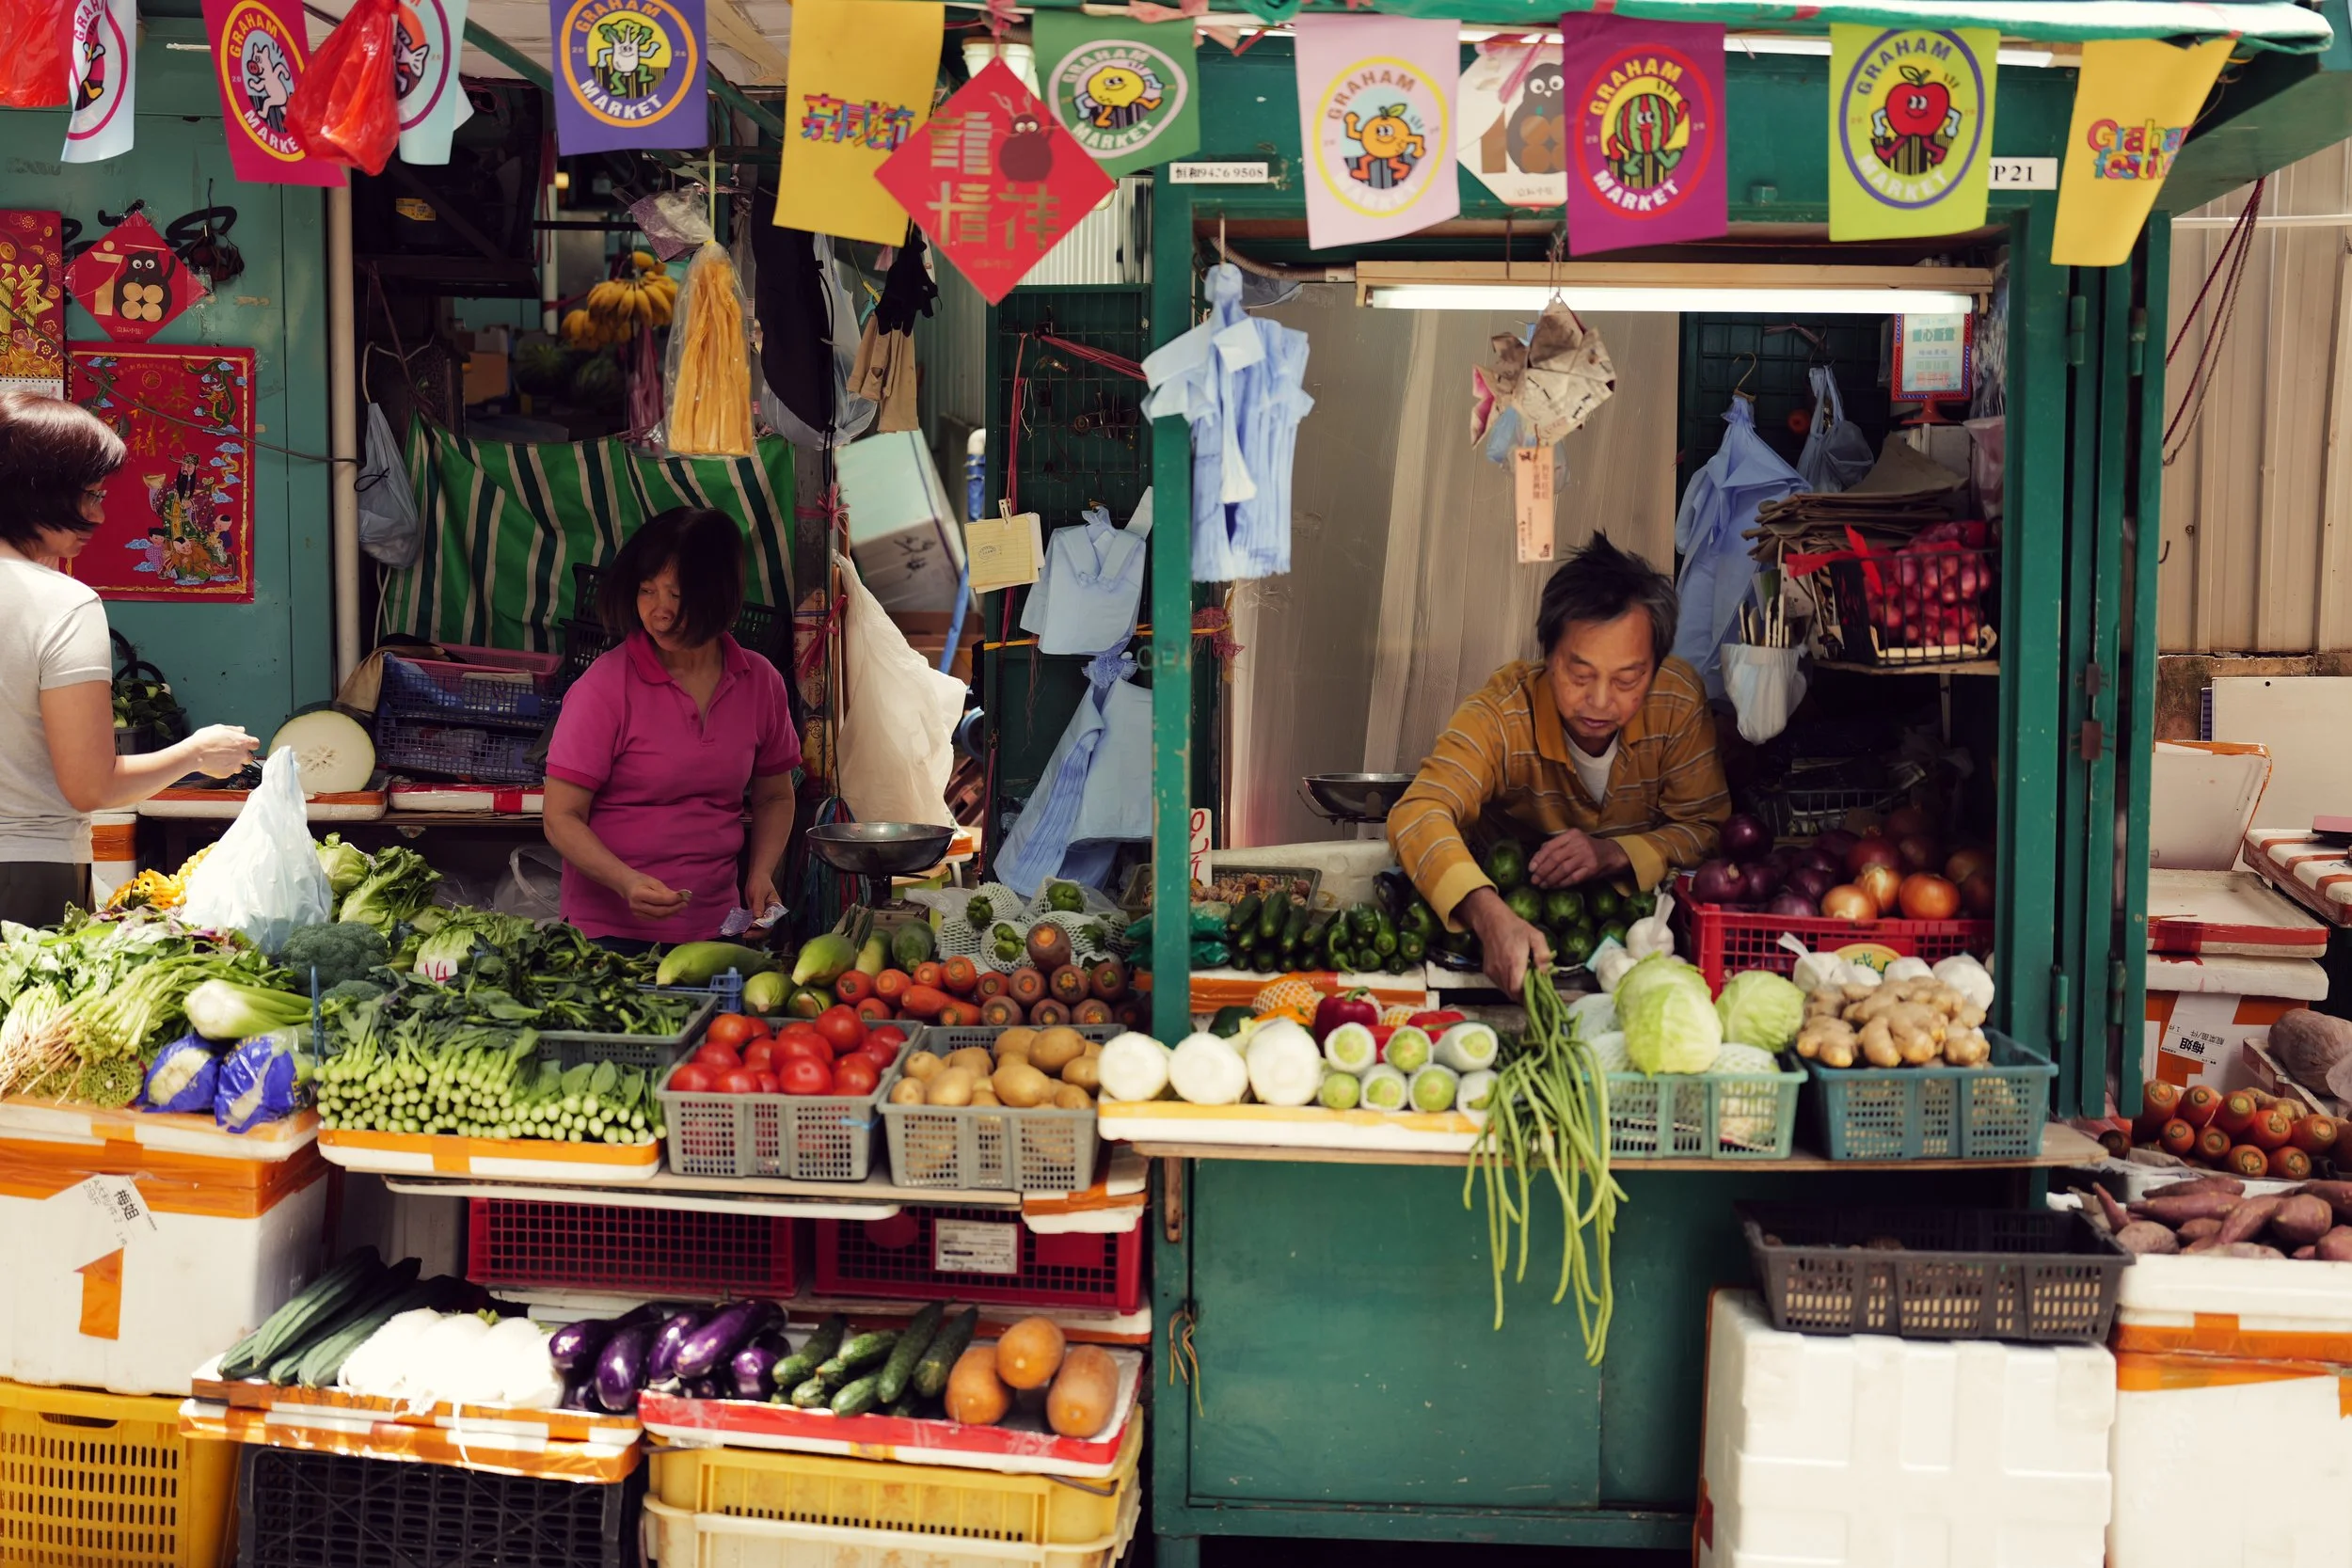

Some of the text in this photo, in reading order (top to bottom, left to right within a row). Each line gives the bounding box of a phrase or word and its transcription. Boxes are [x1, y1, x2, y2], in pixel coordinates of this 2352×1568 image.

[230, 12, 278, 58] GRAHAM
[576, 0, 661, 32] GRAHAM
[1061, 48, 1149, 83] GRAHAM
[1590, 57, 1683, 115] GRAHAM
[1856, 38, 1951, 94] GRAHAM
[580, 79, 662, 119] MARKET
[1327, 71, 1415, 119] GRAHAM
[244, 109, 299, 153] MARKE
[1073, 119, 1152, 150] MARKET
[1593, 168, 1679, 211] MARKET
[1856, 153, 1948, 201] MARKET
[2179, 1037, 2205, 1054] 梅姐
[114, 1189, 139, 1221] 梅姐
